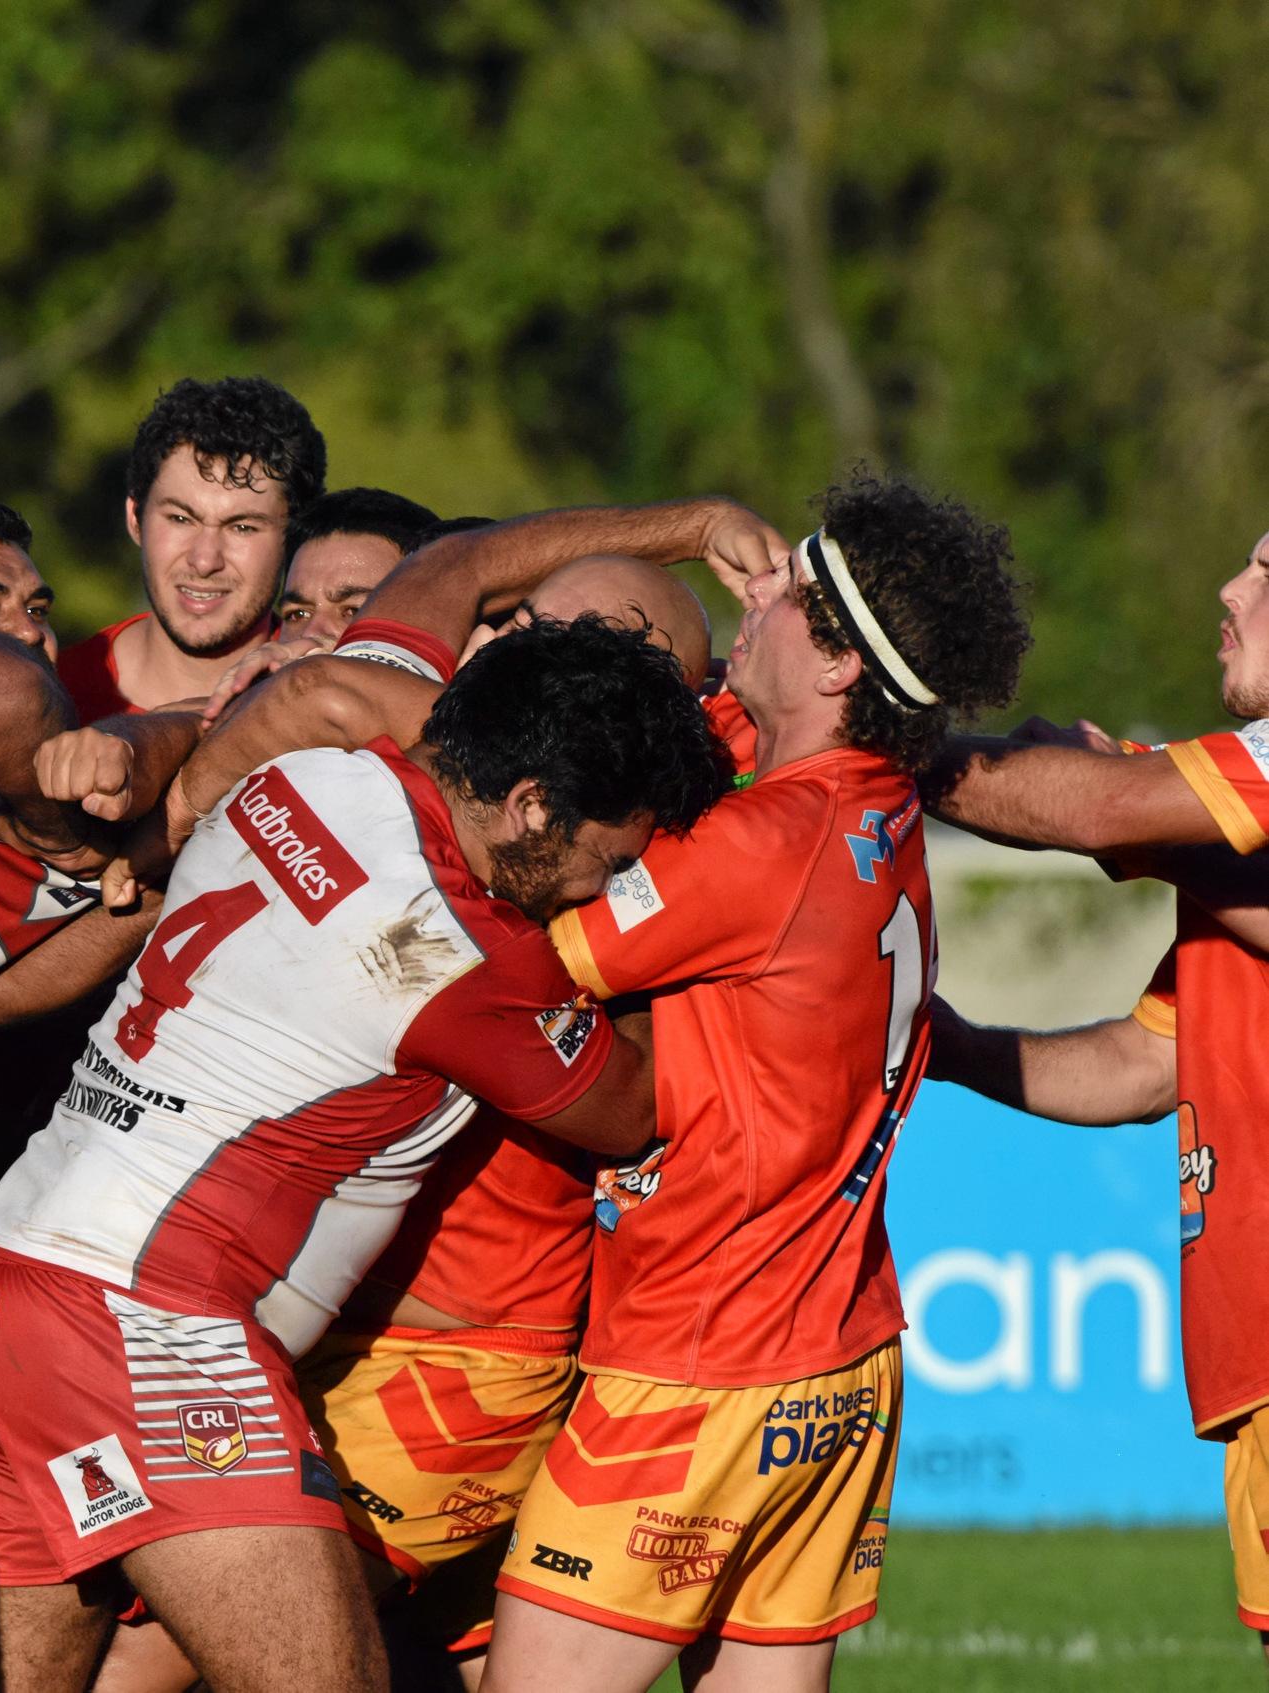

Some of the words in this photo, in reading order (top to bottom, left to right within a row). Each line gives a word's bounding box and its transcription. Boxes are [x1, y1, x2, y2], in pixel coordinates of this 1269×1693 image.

[186, 1408, 236, 1430] CRL
[765, 1395, 829, 1423] park
[86, 1489, 130, 1516] Jacaranda
[458, 1478, 497, 1500] PARK
[79, 1508, 116, 1532] MOTOR
[115, 1496, 146, 1516] LODGE
[636, 1505, 686, 1529] PARK
[688, 1516, 748, 1536] BEACH
[632, 1531, 706, 1558] HOME
[530, 1543, 593, 1582] ZBR
